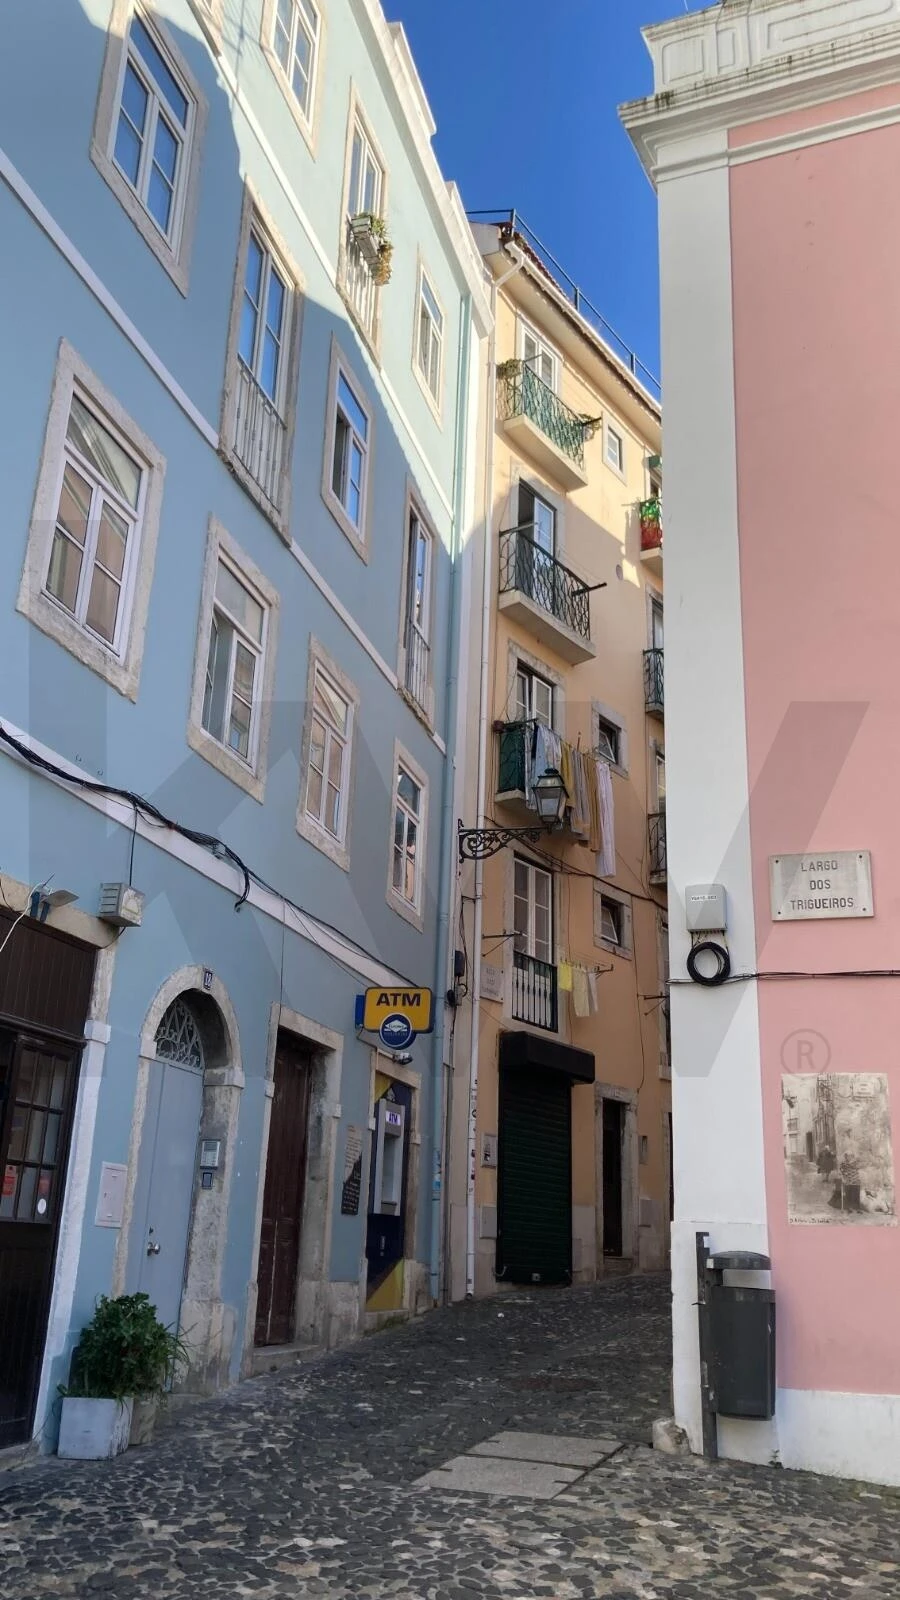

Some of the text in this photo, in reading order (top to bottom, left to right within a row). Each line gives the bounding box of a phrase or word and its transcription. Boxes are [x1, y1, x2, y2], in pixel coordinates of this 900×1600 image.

[801, 860, 838, 872] LARGO
[809, 879, 831, 890] DOS
[790, 898, 854, 911] TRIGUEIROS
[376, 993, 421, 1007] ATM
